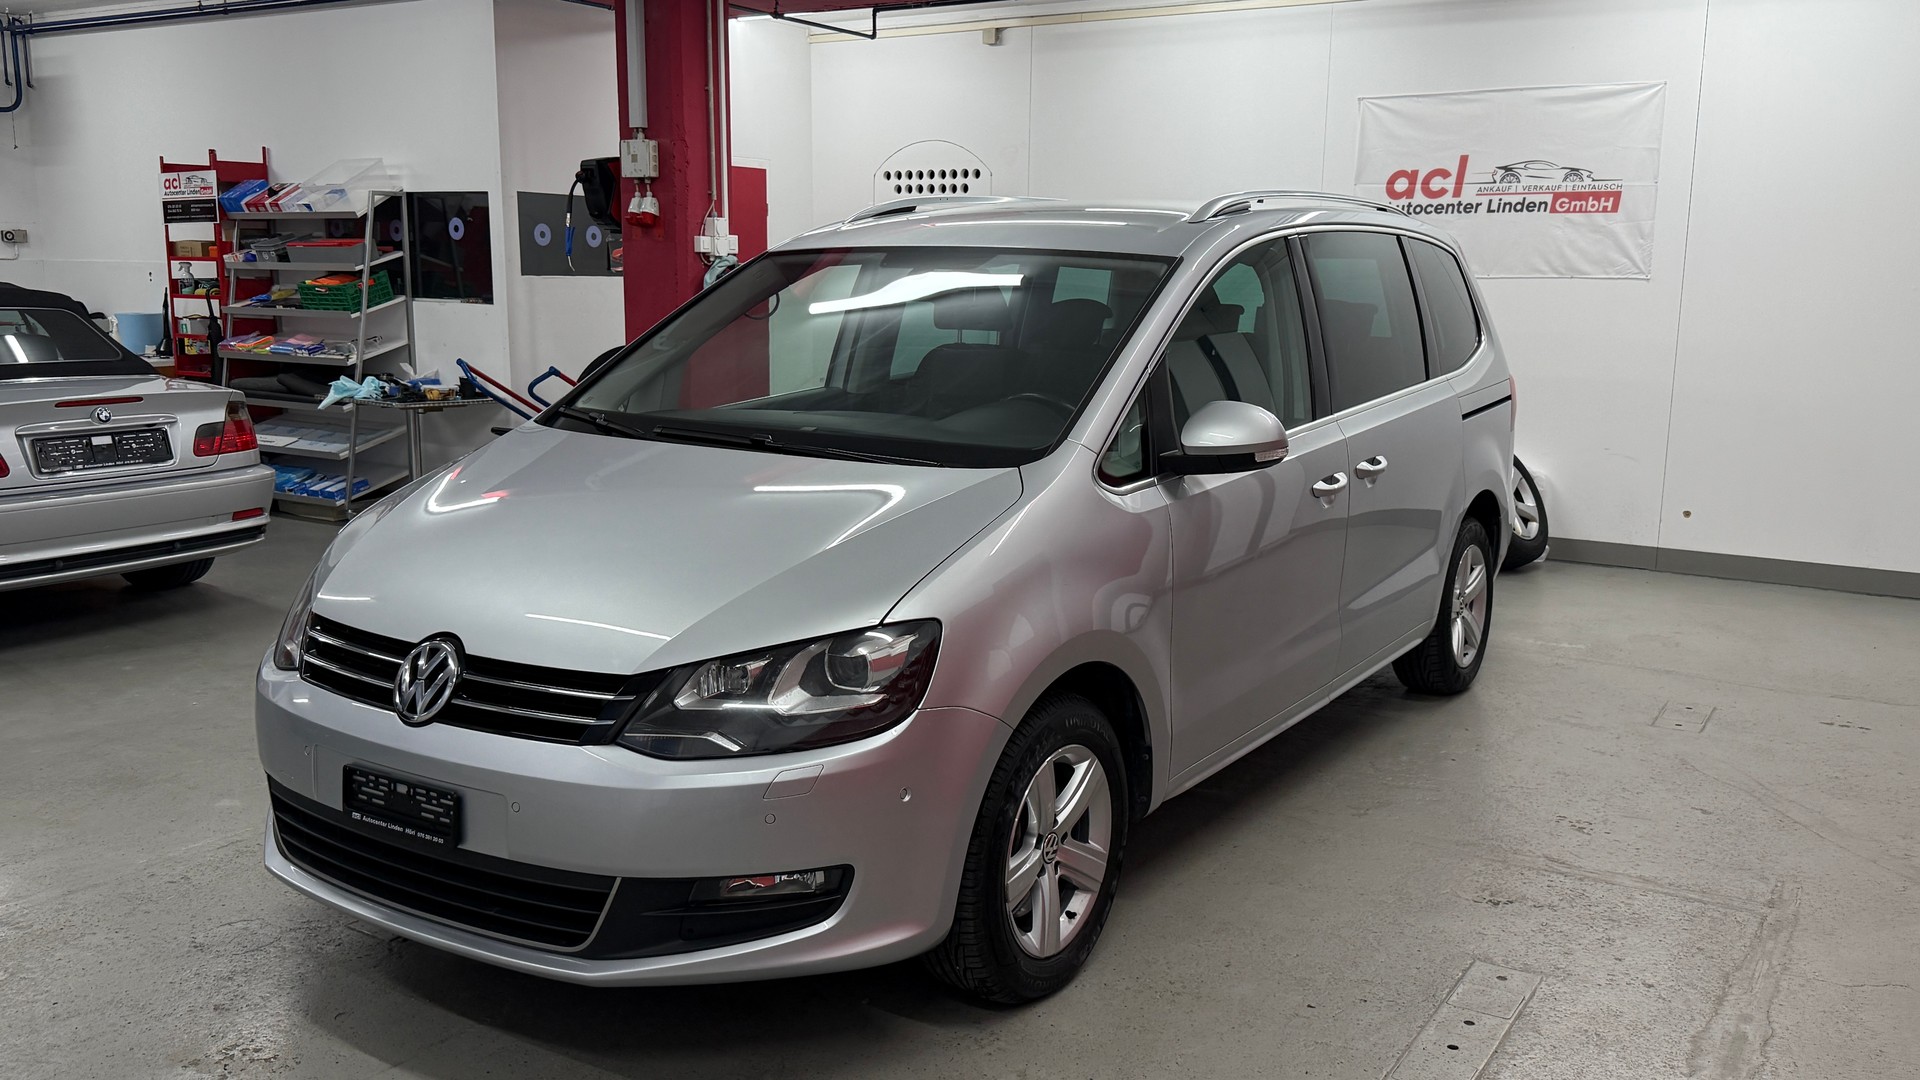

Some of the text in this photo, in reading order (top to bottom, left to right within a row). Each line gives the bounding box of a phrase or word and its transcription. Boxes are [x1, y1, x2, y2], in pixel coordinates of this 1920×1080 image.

[164, 173, 181, 190] acl
[1386, 154, 1469, 200] acl
[1477, 185, 1513, 193] ANKAUF
[1390, 196, 1614, 215] utocenter Linden GmbH
[363, 816, 387, 827] Autocenter
[388, 823, 404, 832] Linden
